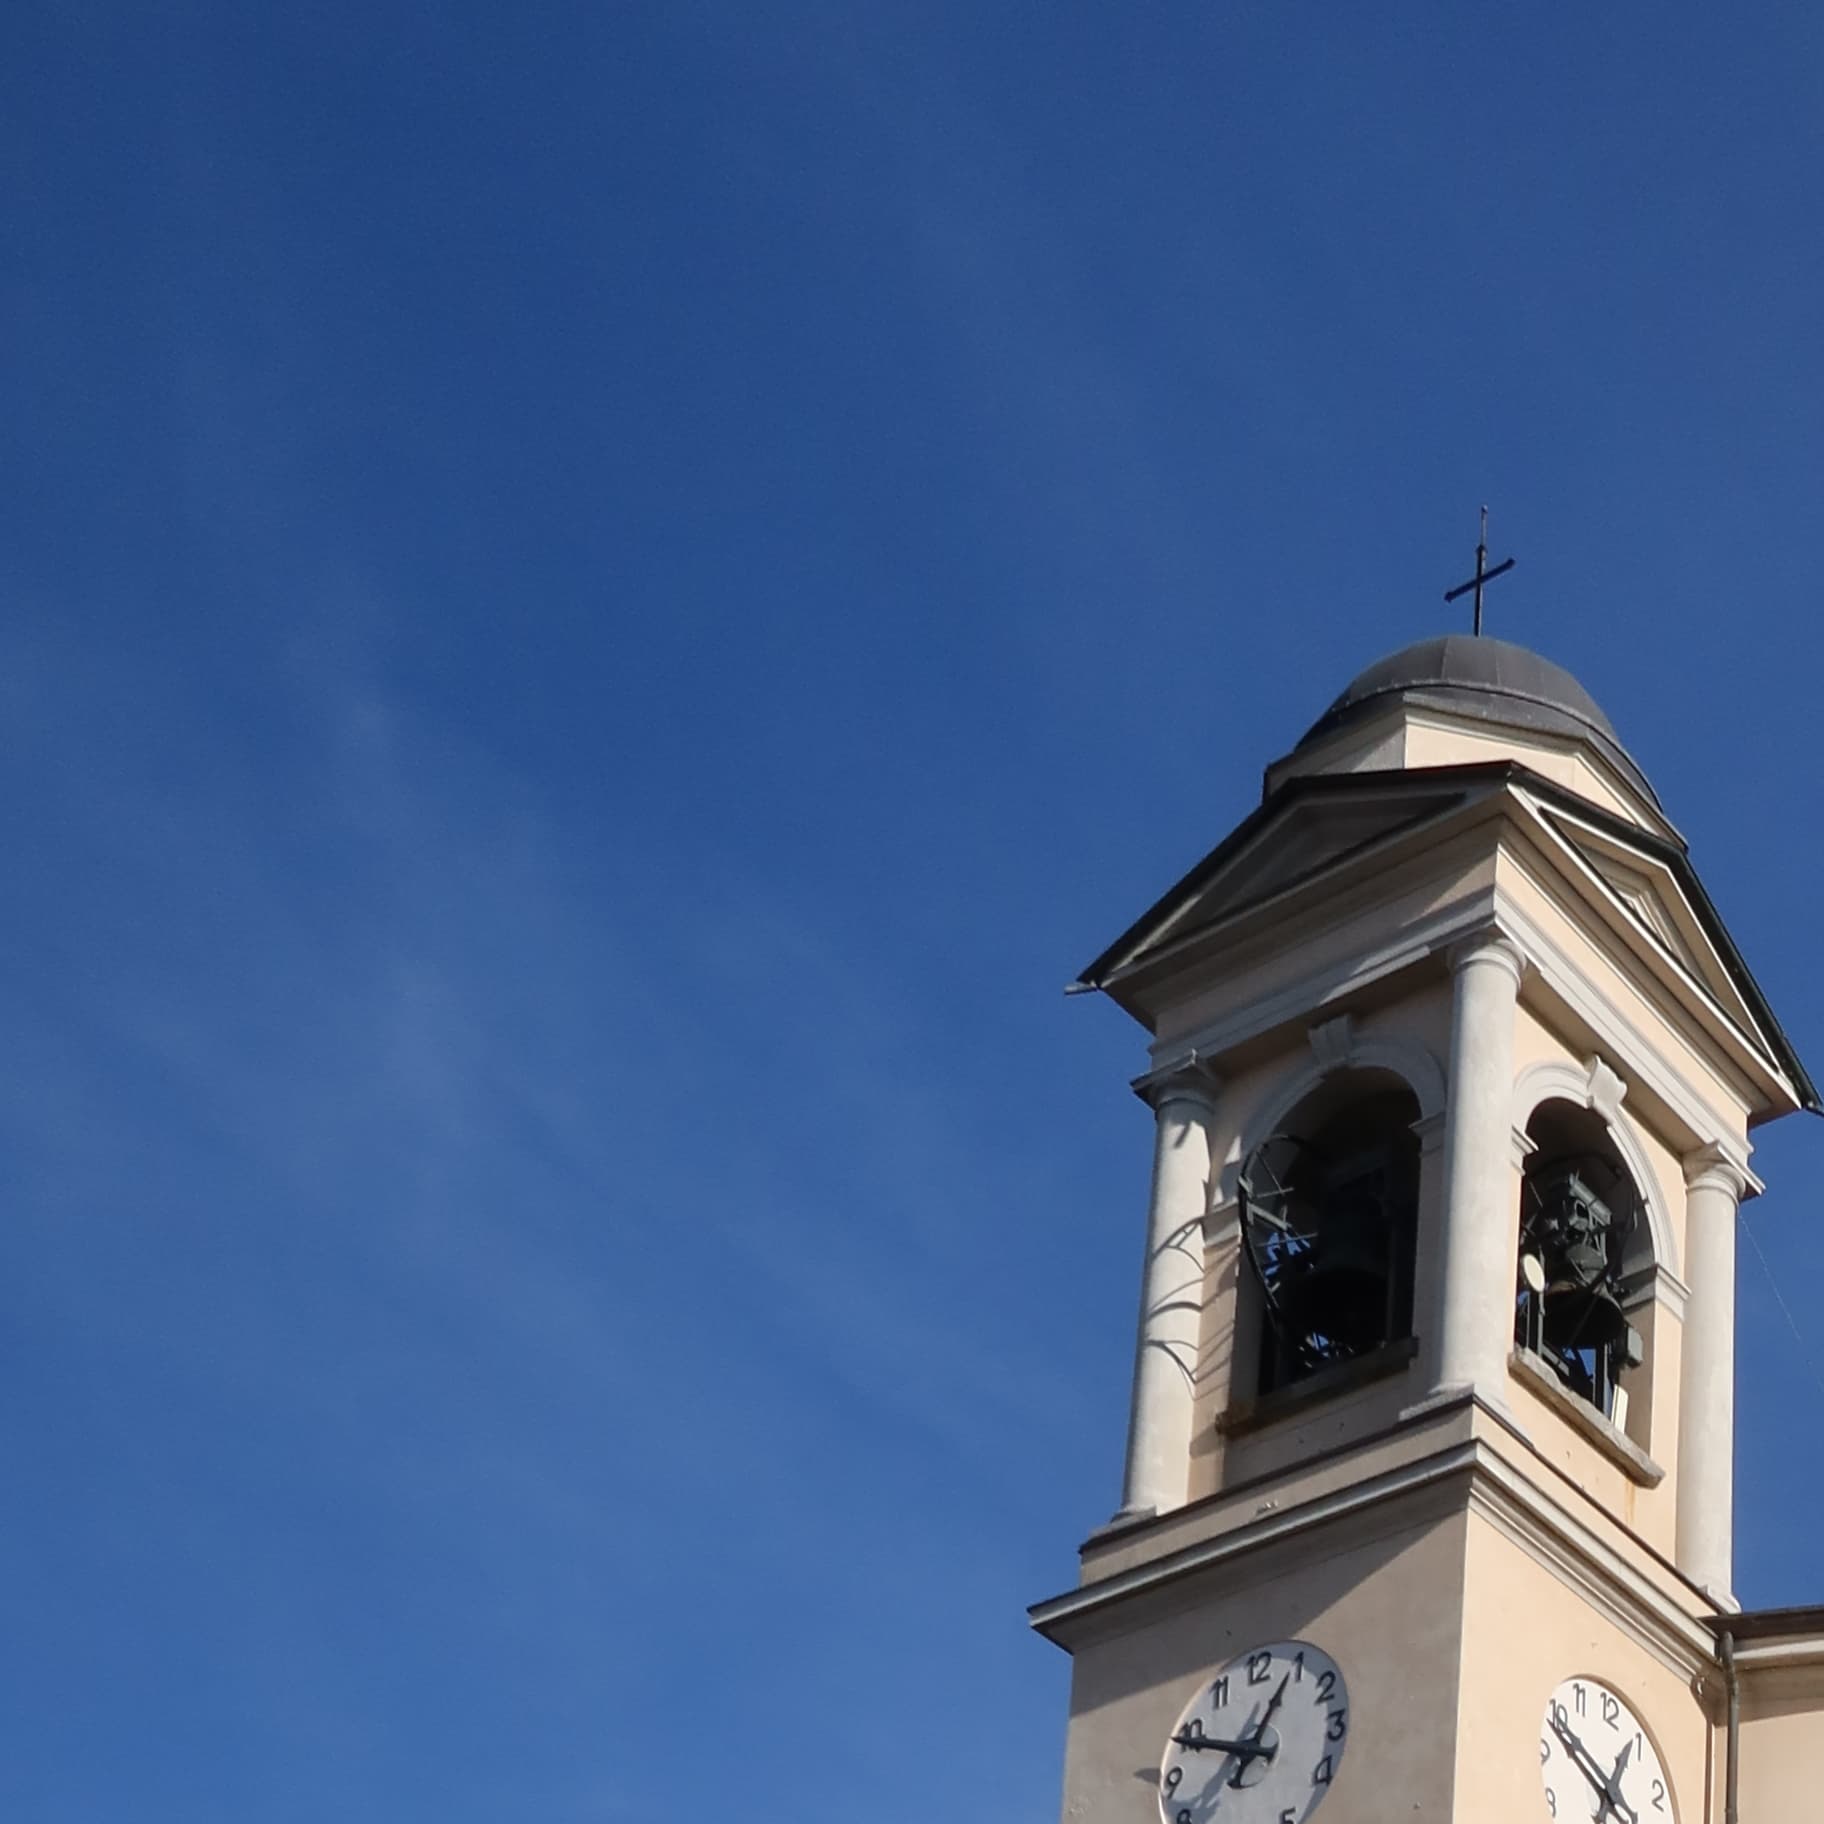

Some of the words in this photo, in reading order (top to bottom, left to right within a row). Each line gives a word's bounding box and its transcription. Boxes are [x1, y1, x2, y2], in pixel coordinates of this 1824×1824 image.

[1245, 1651, 1272, 1685] 12
[1292, 1651, 1305, 1682] 1
[1209, 1675, 1230, 1710] 11
[1314, 1671, 1336, 1706] 2
[1327, 1709, 1346, 1741] 3
[1600, 1691, 1620, 1731] 12
[1634, 1732, 1643, 1762] 1
[1166, 1766, 1183, 1800] 9
[1312, 1755, 1333, 1787] 4
[1652, 1779, 1665, 1813] 2
